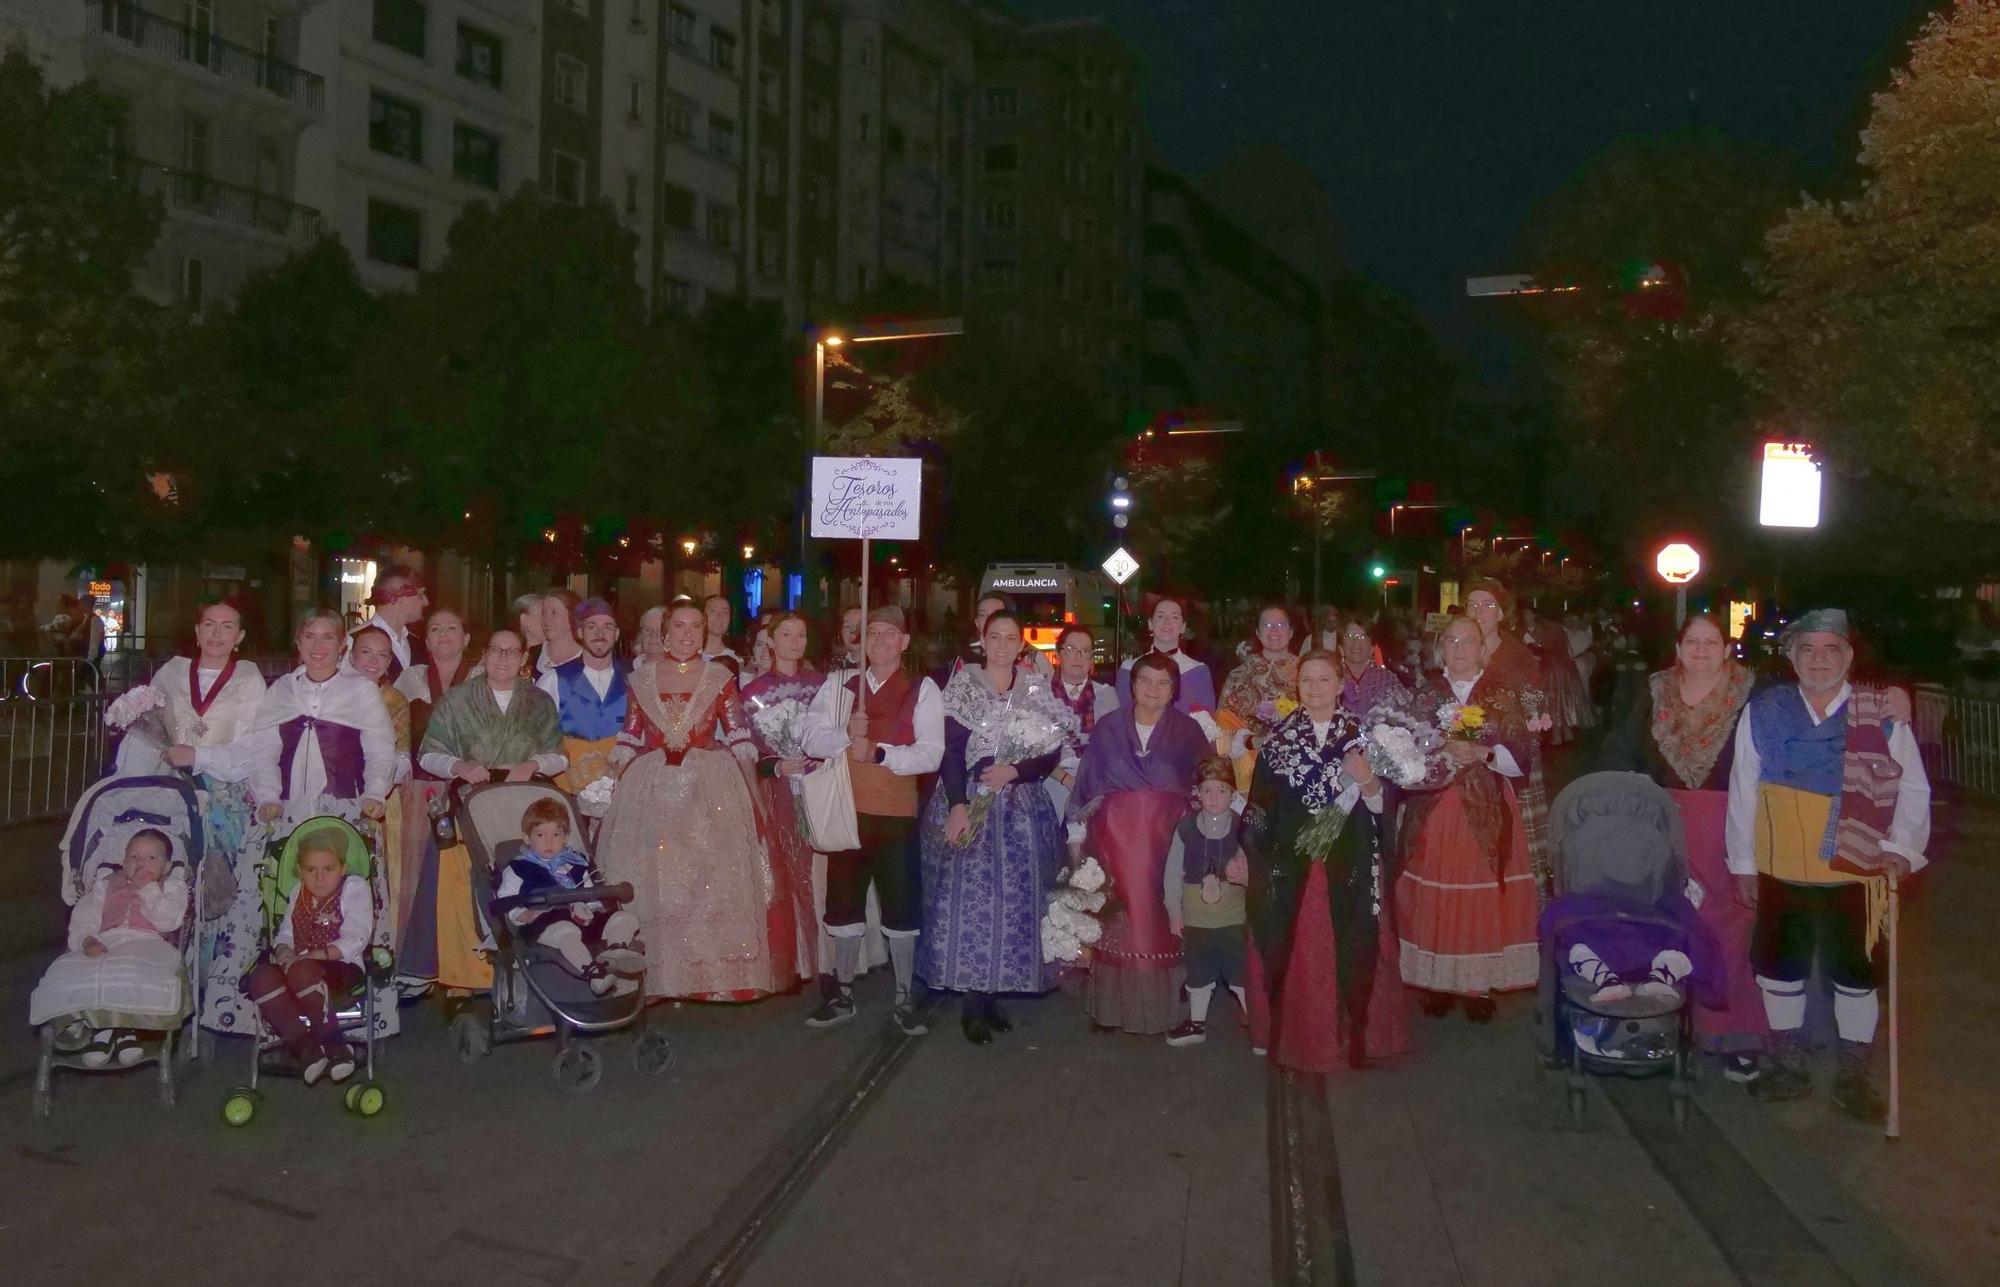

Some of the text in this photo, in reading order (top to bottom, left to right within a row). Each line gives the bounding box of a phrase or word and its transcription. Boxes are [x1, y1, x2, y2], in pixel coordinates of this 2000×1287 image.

[829, 475, 898, 505] Tesoros
[820, 496, 909, 525] Antepasados
[1113, 559, 1129, 573] 30
[89, 581, 111, 591] Todo
[992, 579, 1058, 587] AMBULANCIA
